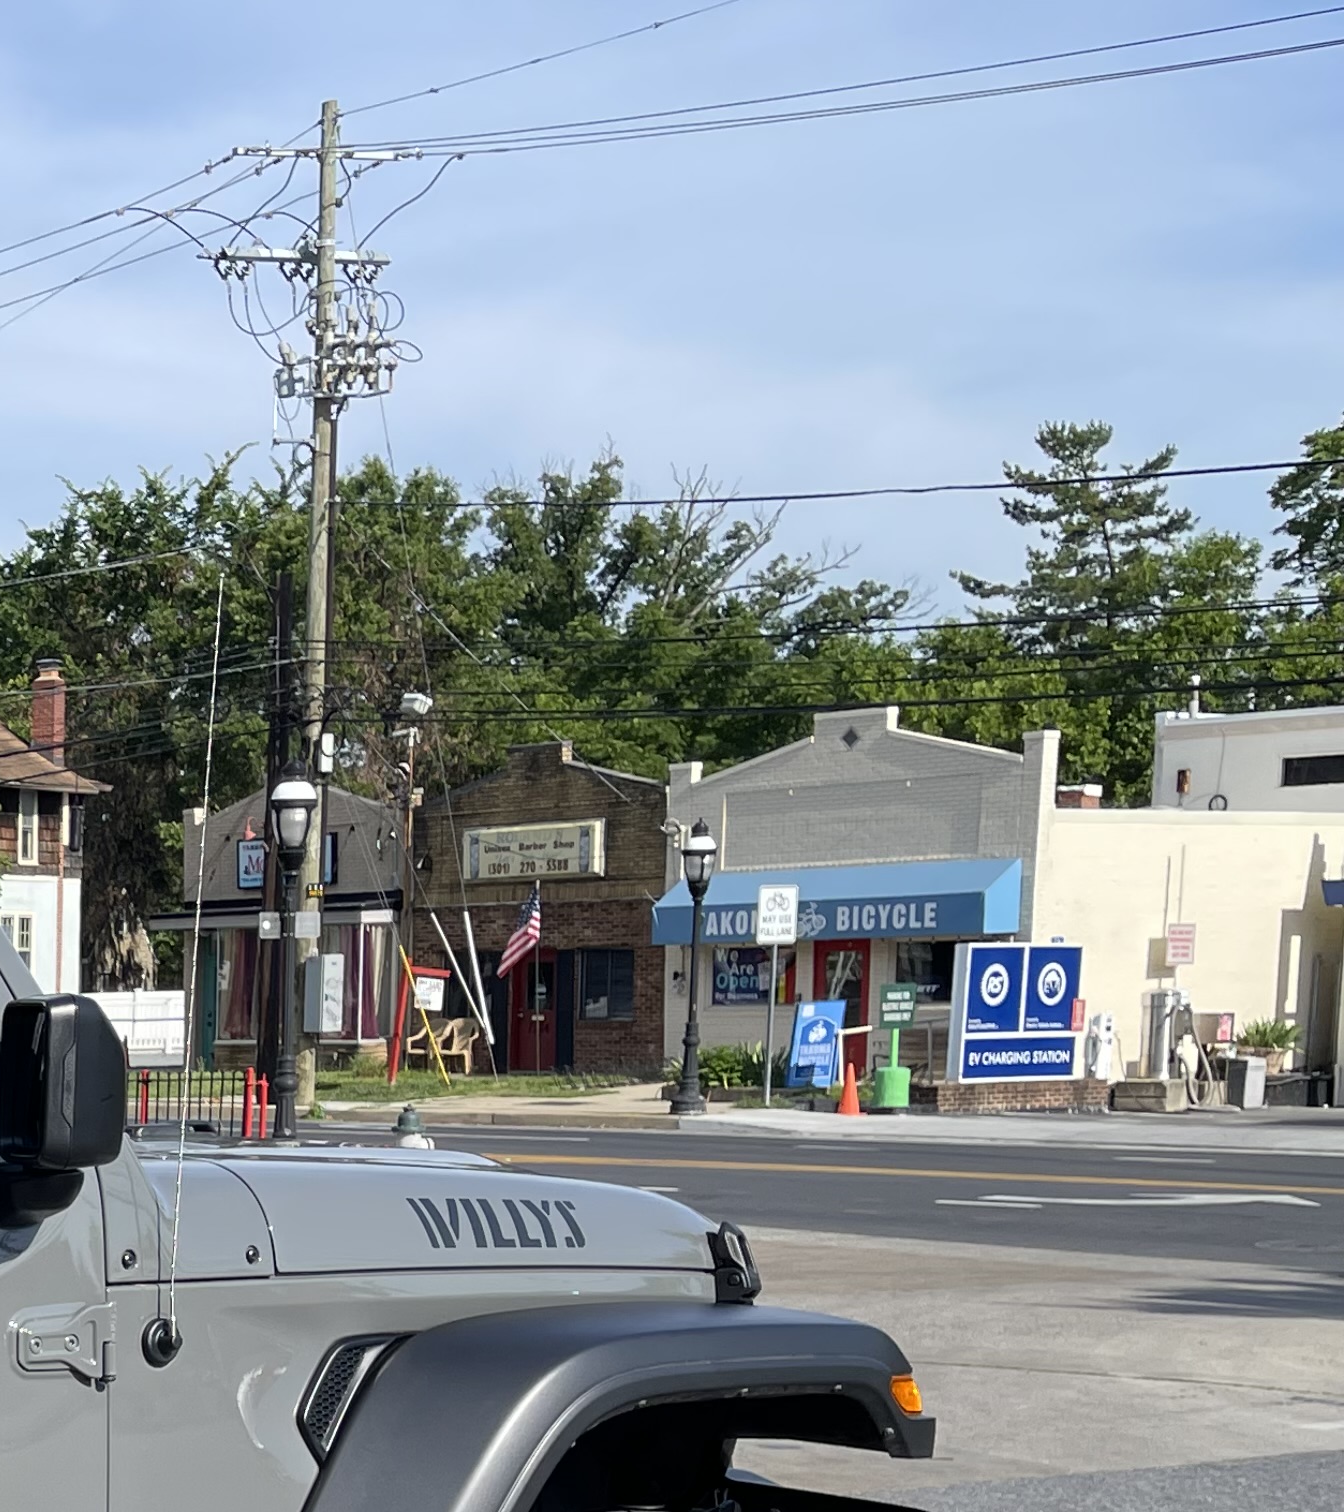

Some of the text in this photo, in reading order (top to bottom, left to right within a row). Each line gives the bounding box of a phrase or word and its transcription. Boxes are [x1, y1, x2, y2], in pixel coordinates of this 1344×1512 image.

[519, 842, 547, 851] Barber
[553, 840, 575, 850] Shop
[488, 863, 510, 875] (301)
[520, 861, 536, 873] 270
[762, 914, 792, 924] MAY USE
[836, 902, 938, 931] BICYCLE
[760, 926, 792, 936] FULL LANE
[716, 948, 739, 962] We
[730, 962, 754, 975] Are
[716, 973, 759, 993] Open
[968, 1050, 1070, 1066] EV CHARGING STATION
[405, 1197, 586, 1248] WILLYS
